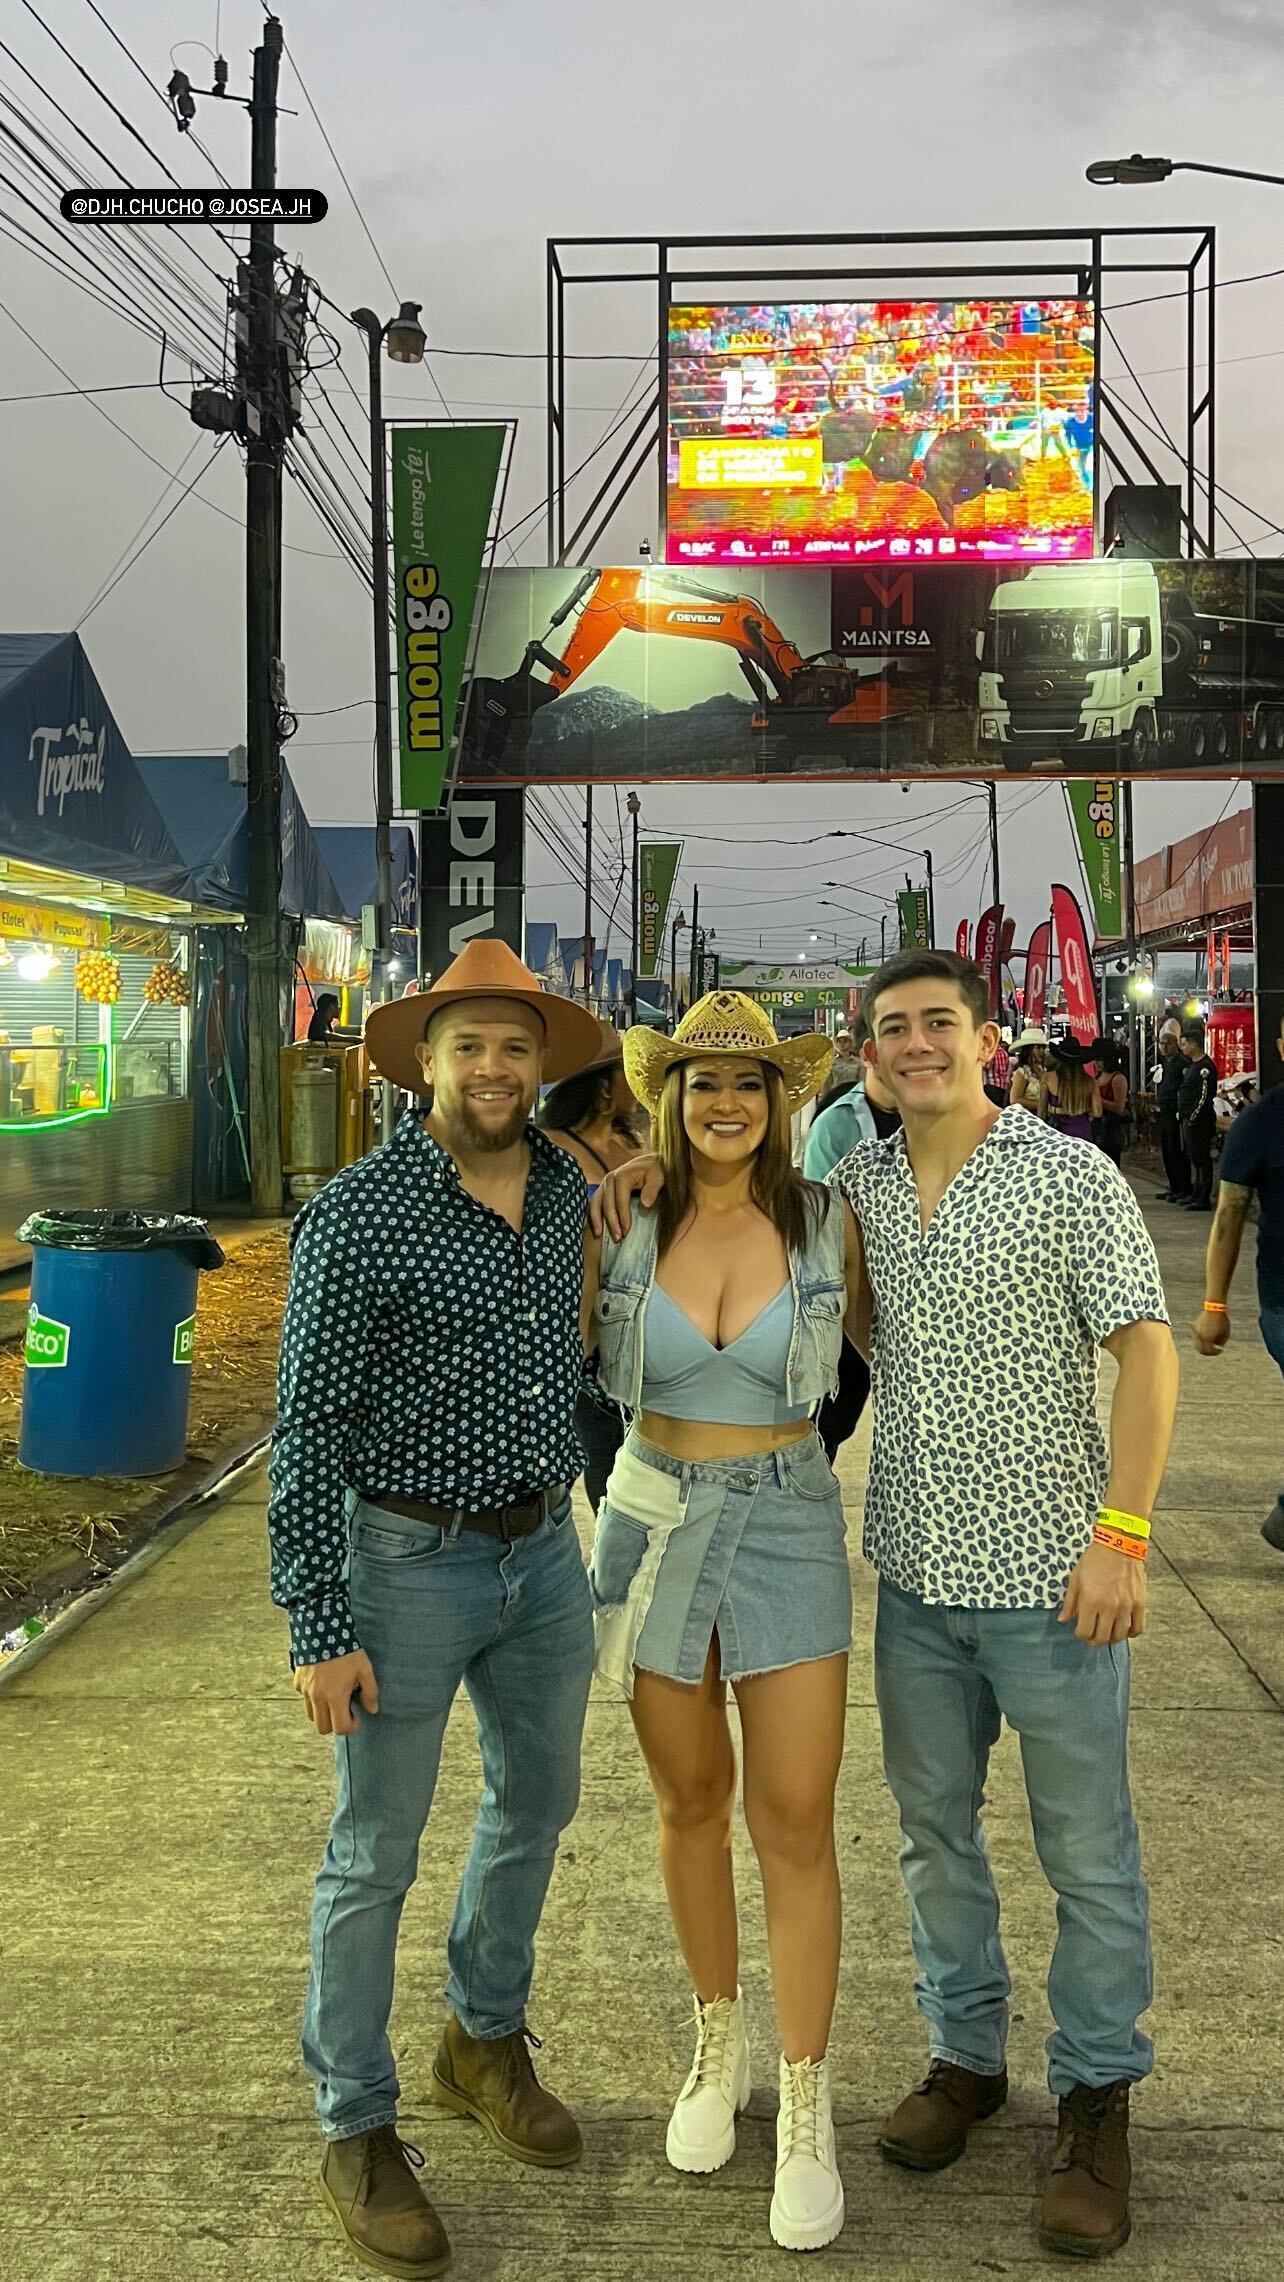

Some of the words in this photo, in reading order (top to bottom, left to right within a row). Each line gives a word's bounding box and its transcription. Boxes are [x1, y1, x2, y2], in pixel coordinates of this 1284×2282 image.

[721, 370, 777, 406] 13
[411, 480, 427, 527] tengo
[677, 613, 720, 623] DEVELON
[842, 630, 931, 646] MAINTSA
[404, 564, 450, 751] monge
[29, 724, 105, 816] Tropical
[1089, 780, 1114, 838] nge
[2, 911, 25, 928] Elotes
[643, 889, 660, 955] monge
[914, 897, 927, 946] monge
[789, 967, 835, 980] Alfatec
